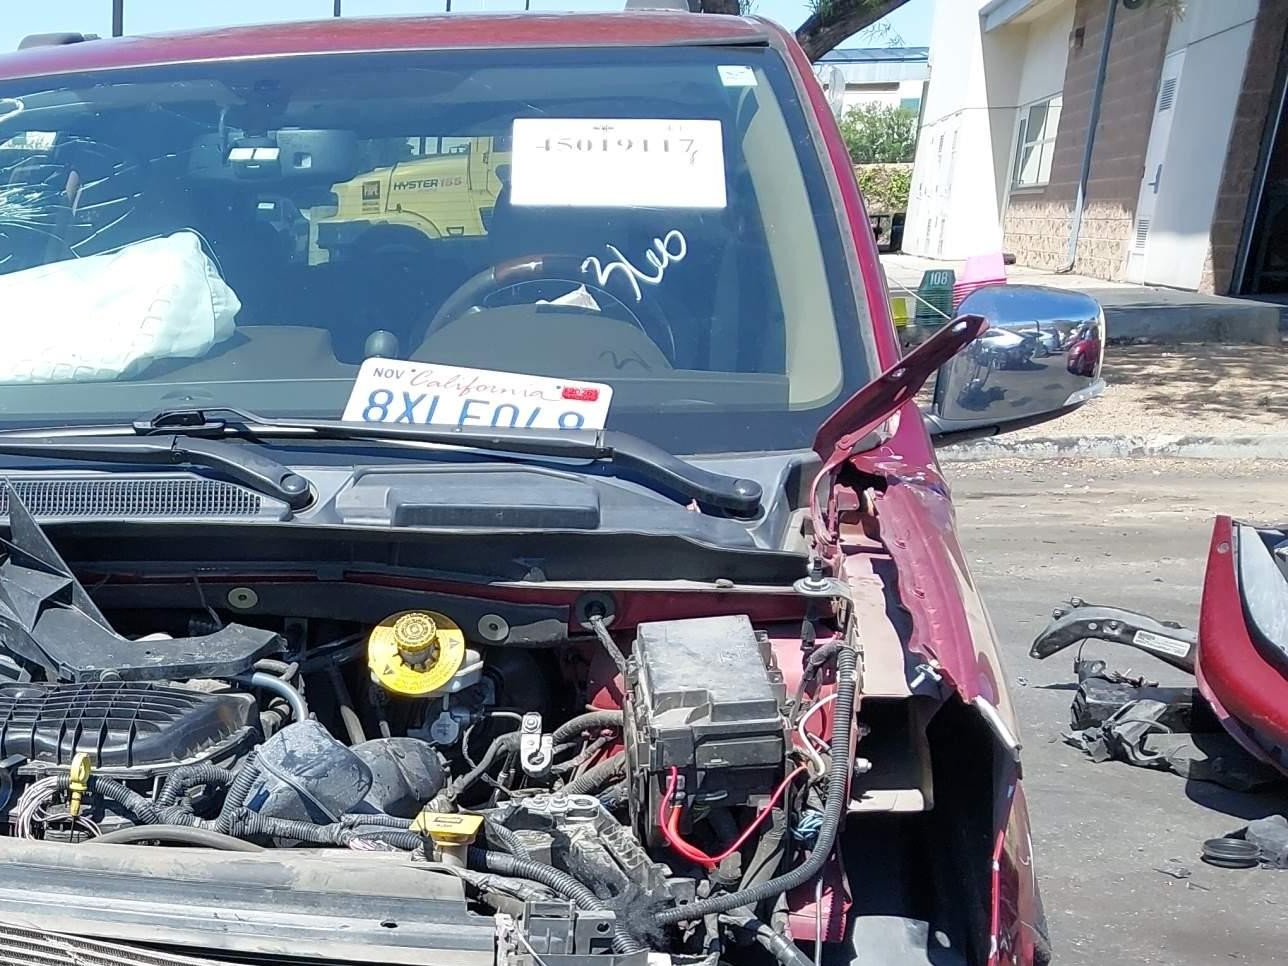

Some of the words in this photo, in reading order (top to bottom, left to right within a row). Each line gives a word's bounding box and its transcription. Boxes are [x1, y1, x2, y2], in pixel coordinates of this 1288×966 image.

[393, 178, 439, 191] HYSTER
[929, 271, 948, 286] 108
[373, 367, 405, 380] NOV
[409, 369, 560, 402] California
